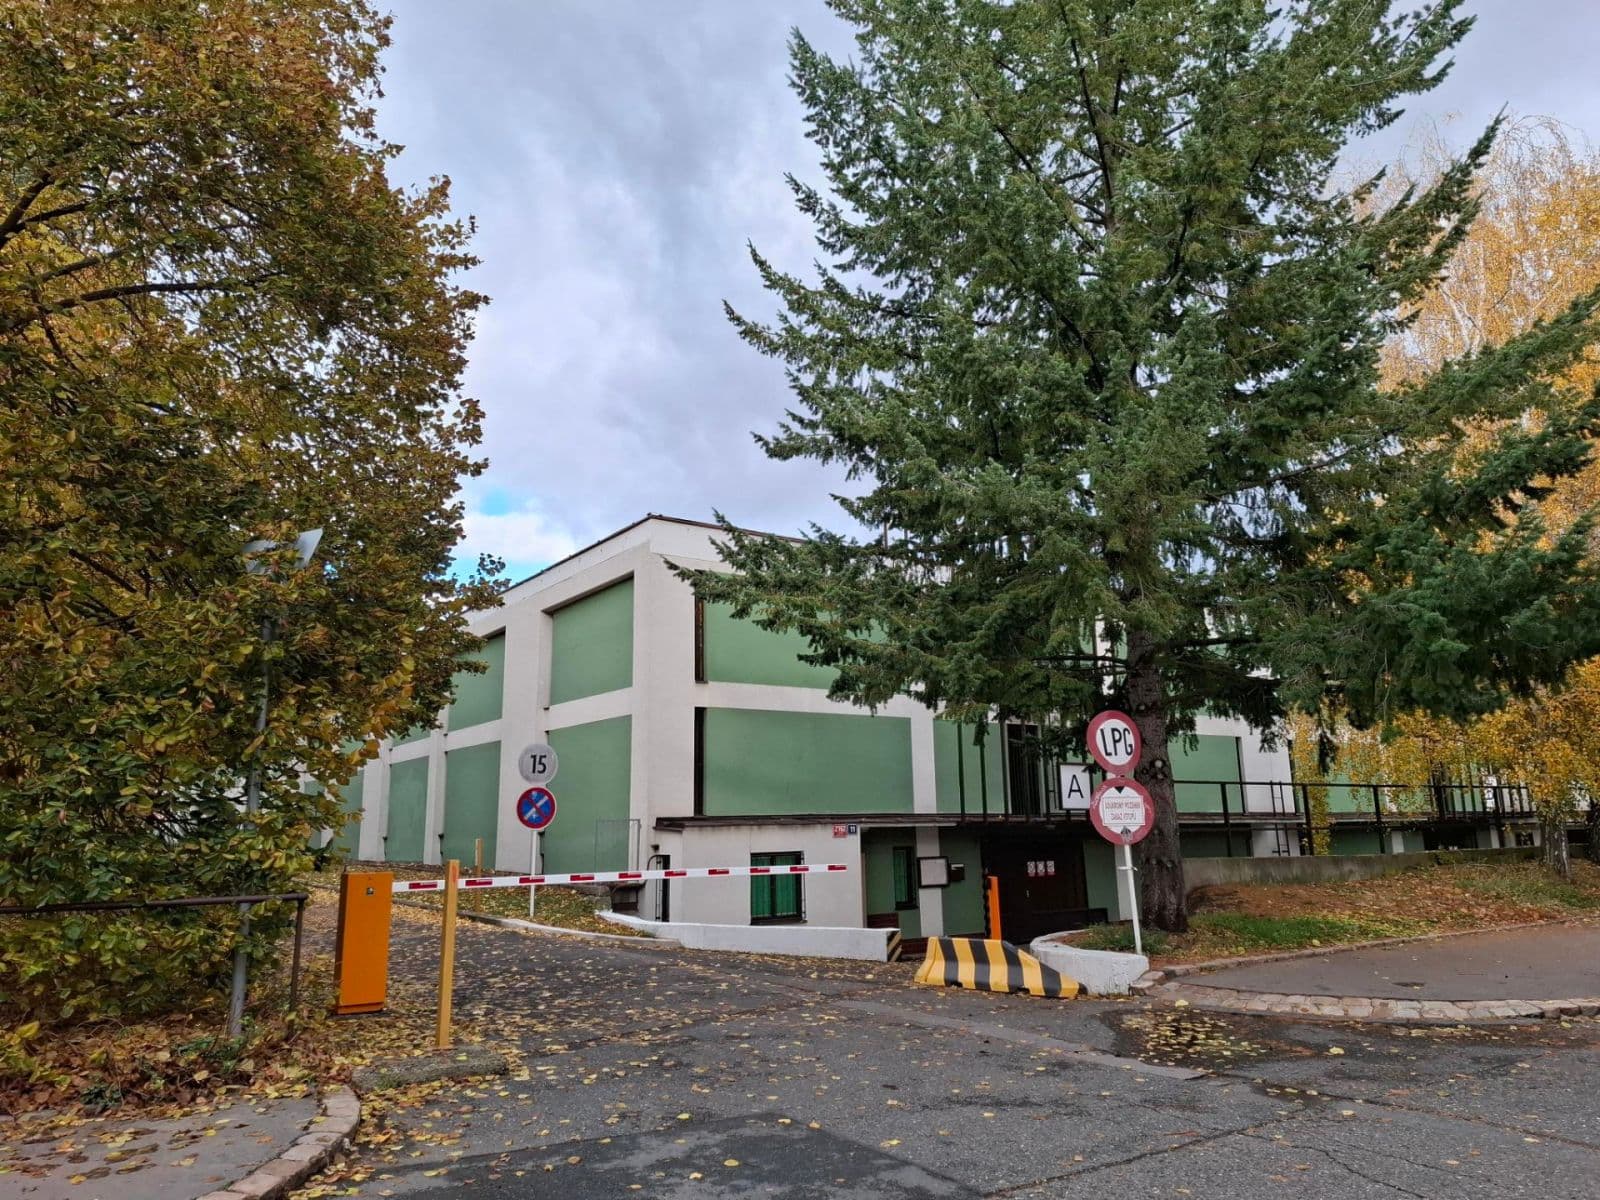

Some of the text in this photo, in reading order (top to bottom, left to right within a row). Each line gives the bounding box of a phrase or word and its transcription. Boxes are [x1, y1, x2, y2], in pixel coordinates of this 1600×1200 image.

[1100, 727, 1133, 757] LPG
[530, 754, 547, 774] 15
[1067, 774, 1084, 799] A
